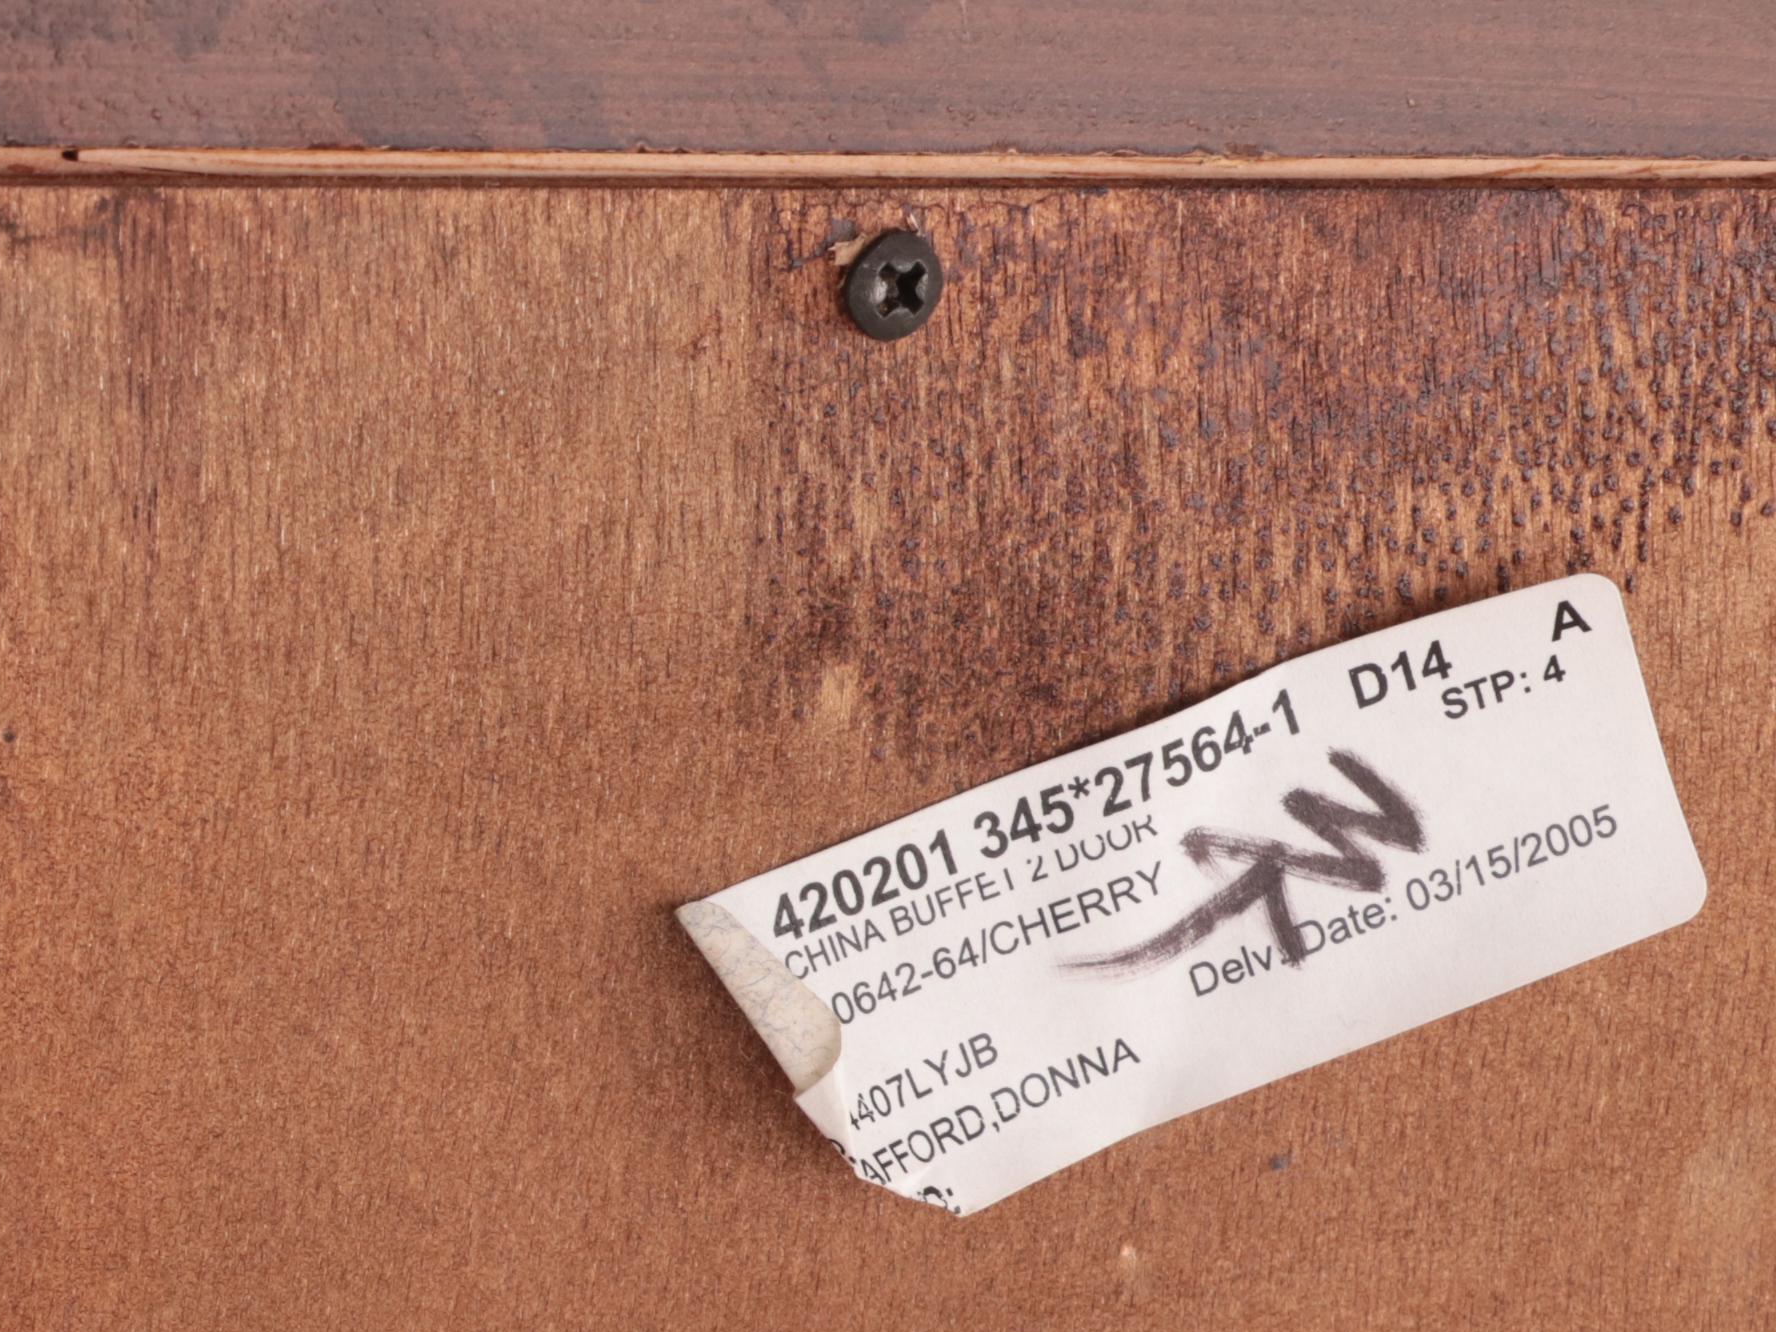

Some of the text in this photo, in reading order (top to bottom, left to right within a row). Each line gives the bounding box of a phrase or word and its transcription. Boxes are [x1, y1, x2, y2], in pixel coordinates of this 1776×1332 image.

[1441, 654, 1566, 720] STP: 4
[772, 829, 959, 942] 420201
[1348, 639, 1453, 709] D14
[1552, 600, 1593, 642] A
[785, 918, 887, 980] CHINA
[889, 867, 1015, 937] BUFFET
[1025, 854, 1048, 883] 2
[1299, 894, 1399, 956] Date:
[1405, 804, 1619, 913] 03/15/2005
